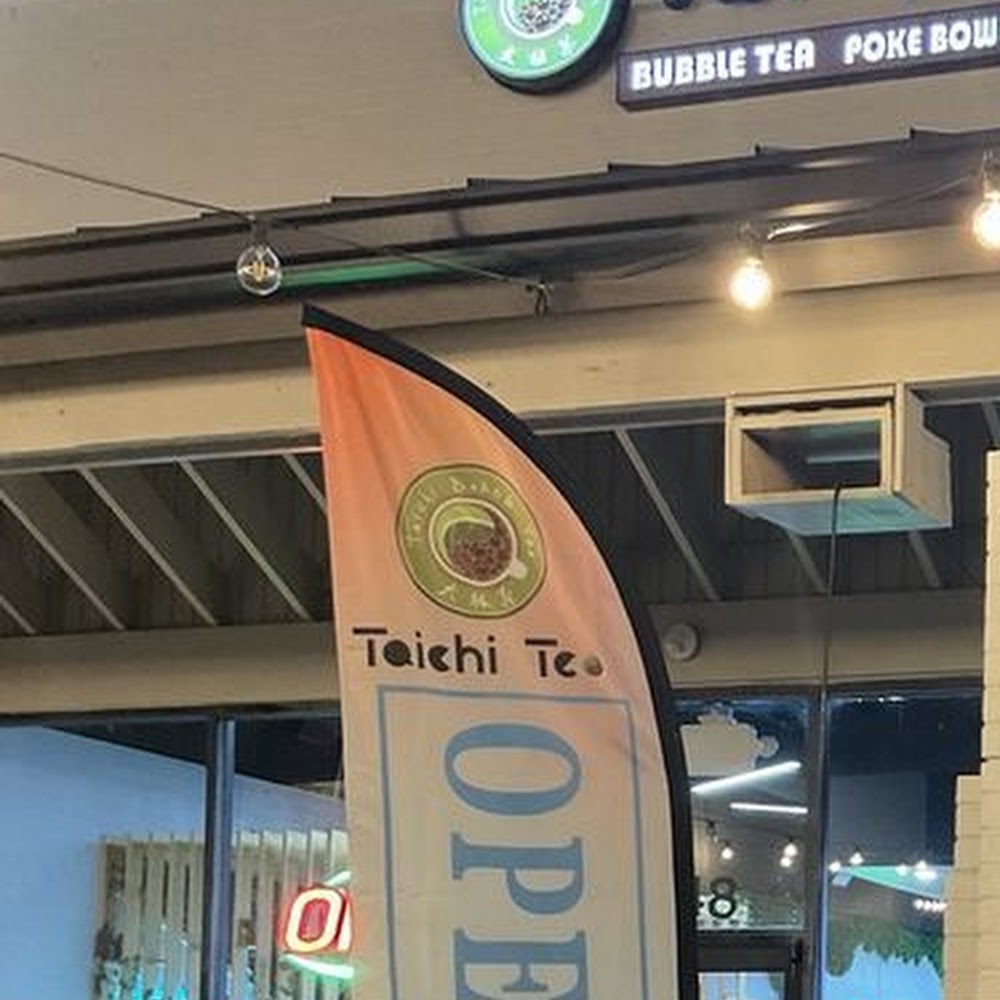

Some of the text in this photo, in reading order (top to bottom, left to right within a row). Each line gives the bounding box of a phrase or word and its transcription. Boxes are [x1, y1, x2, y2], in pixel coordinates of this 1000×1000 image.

[631, 53, 747, 91] BUBBLE
[753, 38, 815, 75] TEA
[843, 27, 922, 65] POKE
[352, 627, 498, 675] Taichi
[699, 877, 738, 919] 8
